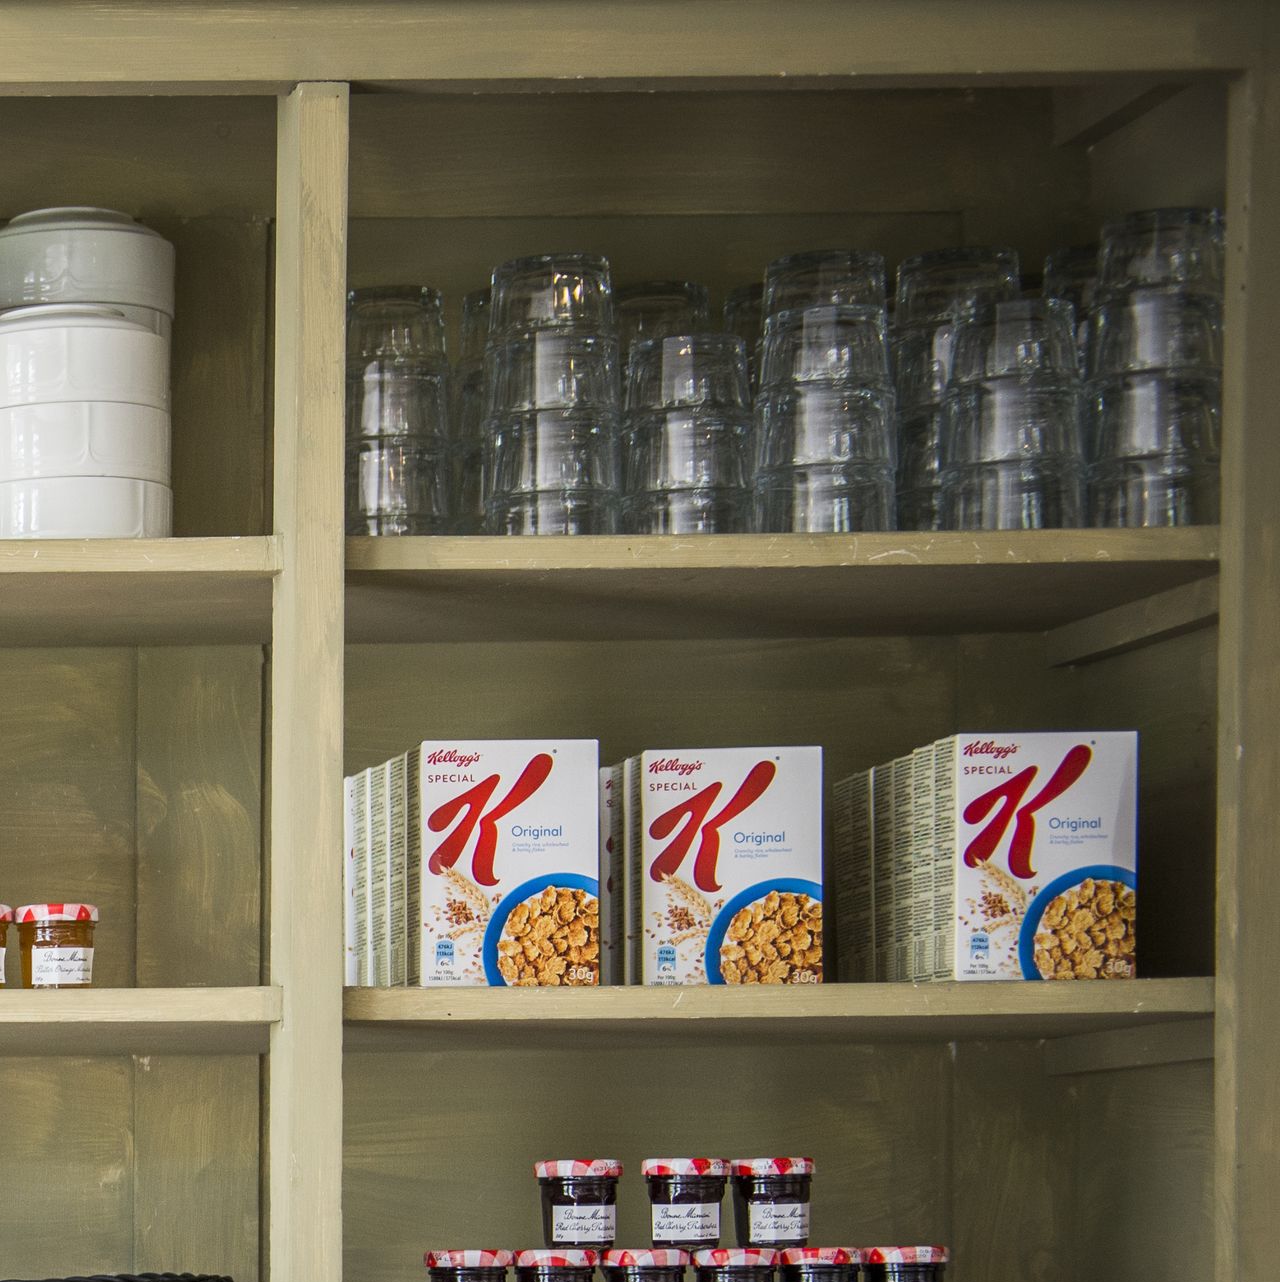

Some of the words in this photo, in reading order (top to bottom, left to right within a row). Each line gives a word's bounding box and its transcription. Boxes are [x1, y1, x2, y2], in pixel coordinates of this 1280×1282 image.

[963, 740, 1018, 759] Kellogg's
[427, 749, 480, 768] Kellogg's
[649, 758, 703, 775] Kellogg's
[964, 766, 1012, 775] SPECIAL
[428, 774, 475, 783] SPECIAL
[649, 782, 697, 791] SPECIAL
[963, 744, 1092, 879] K
[427, 753, 554, 887] K
[649, 760, 776, 892] K
[1049, 817, 1101, 831] Original
[511, 825, 562, 840] Original
[734, 832, 785, 845] Original
[568, 968, 593, 982] 30g
[1106, 960, 1132, 975] 30g
[792, 971, 817, 984] 30g
